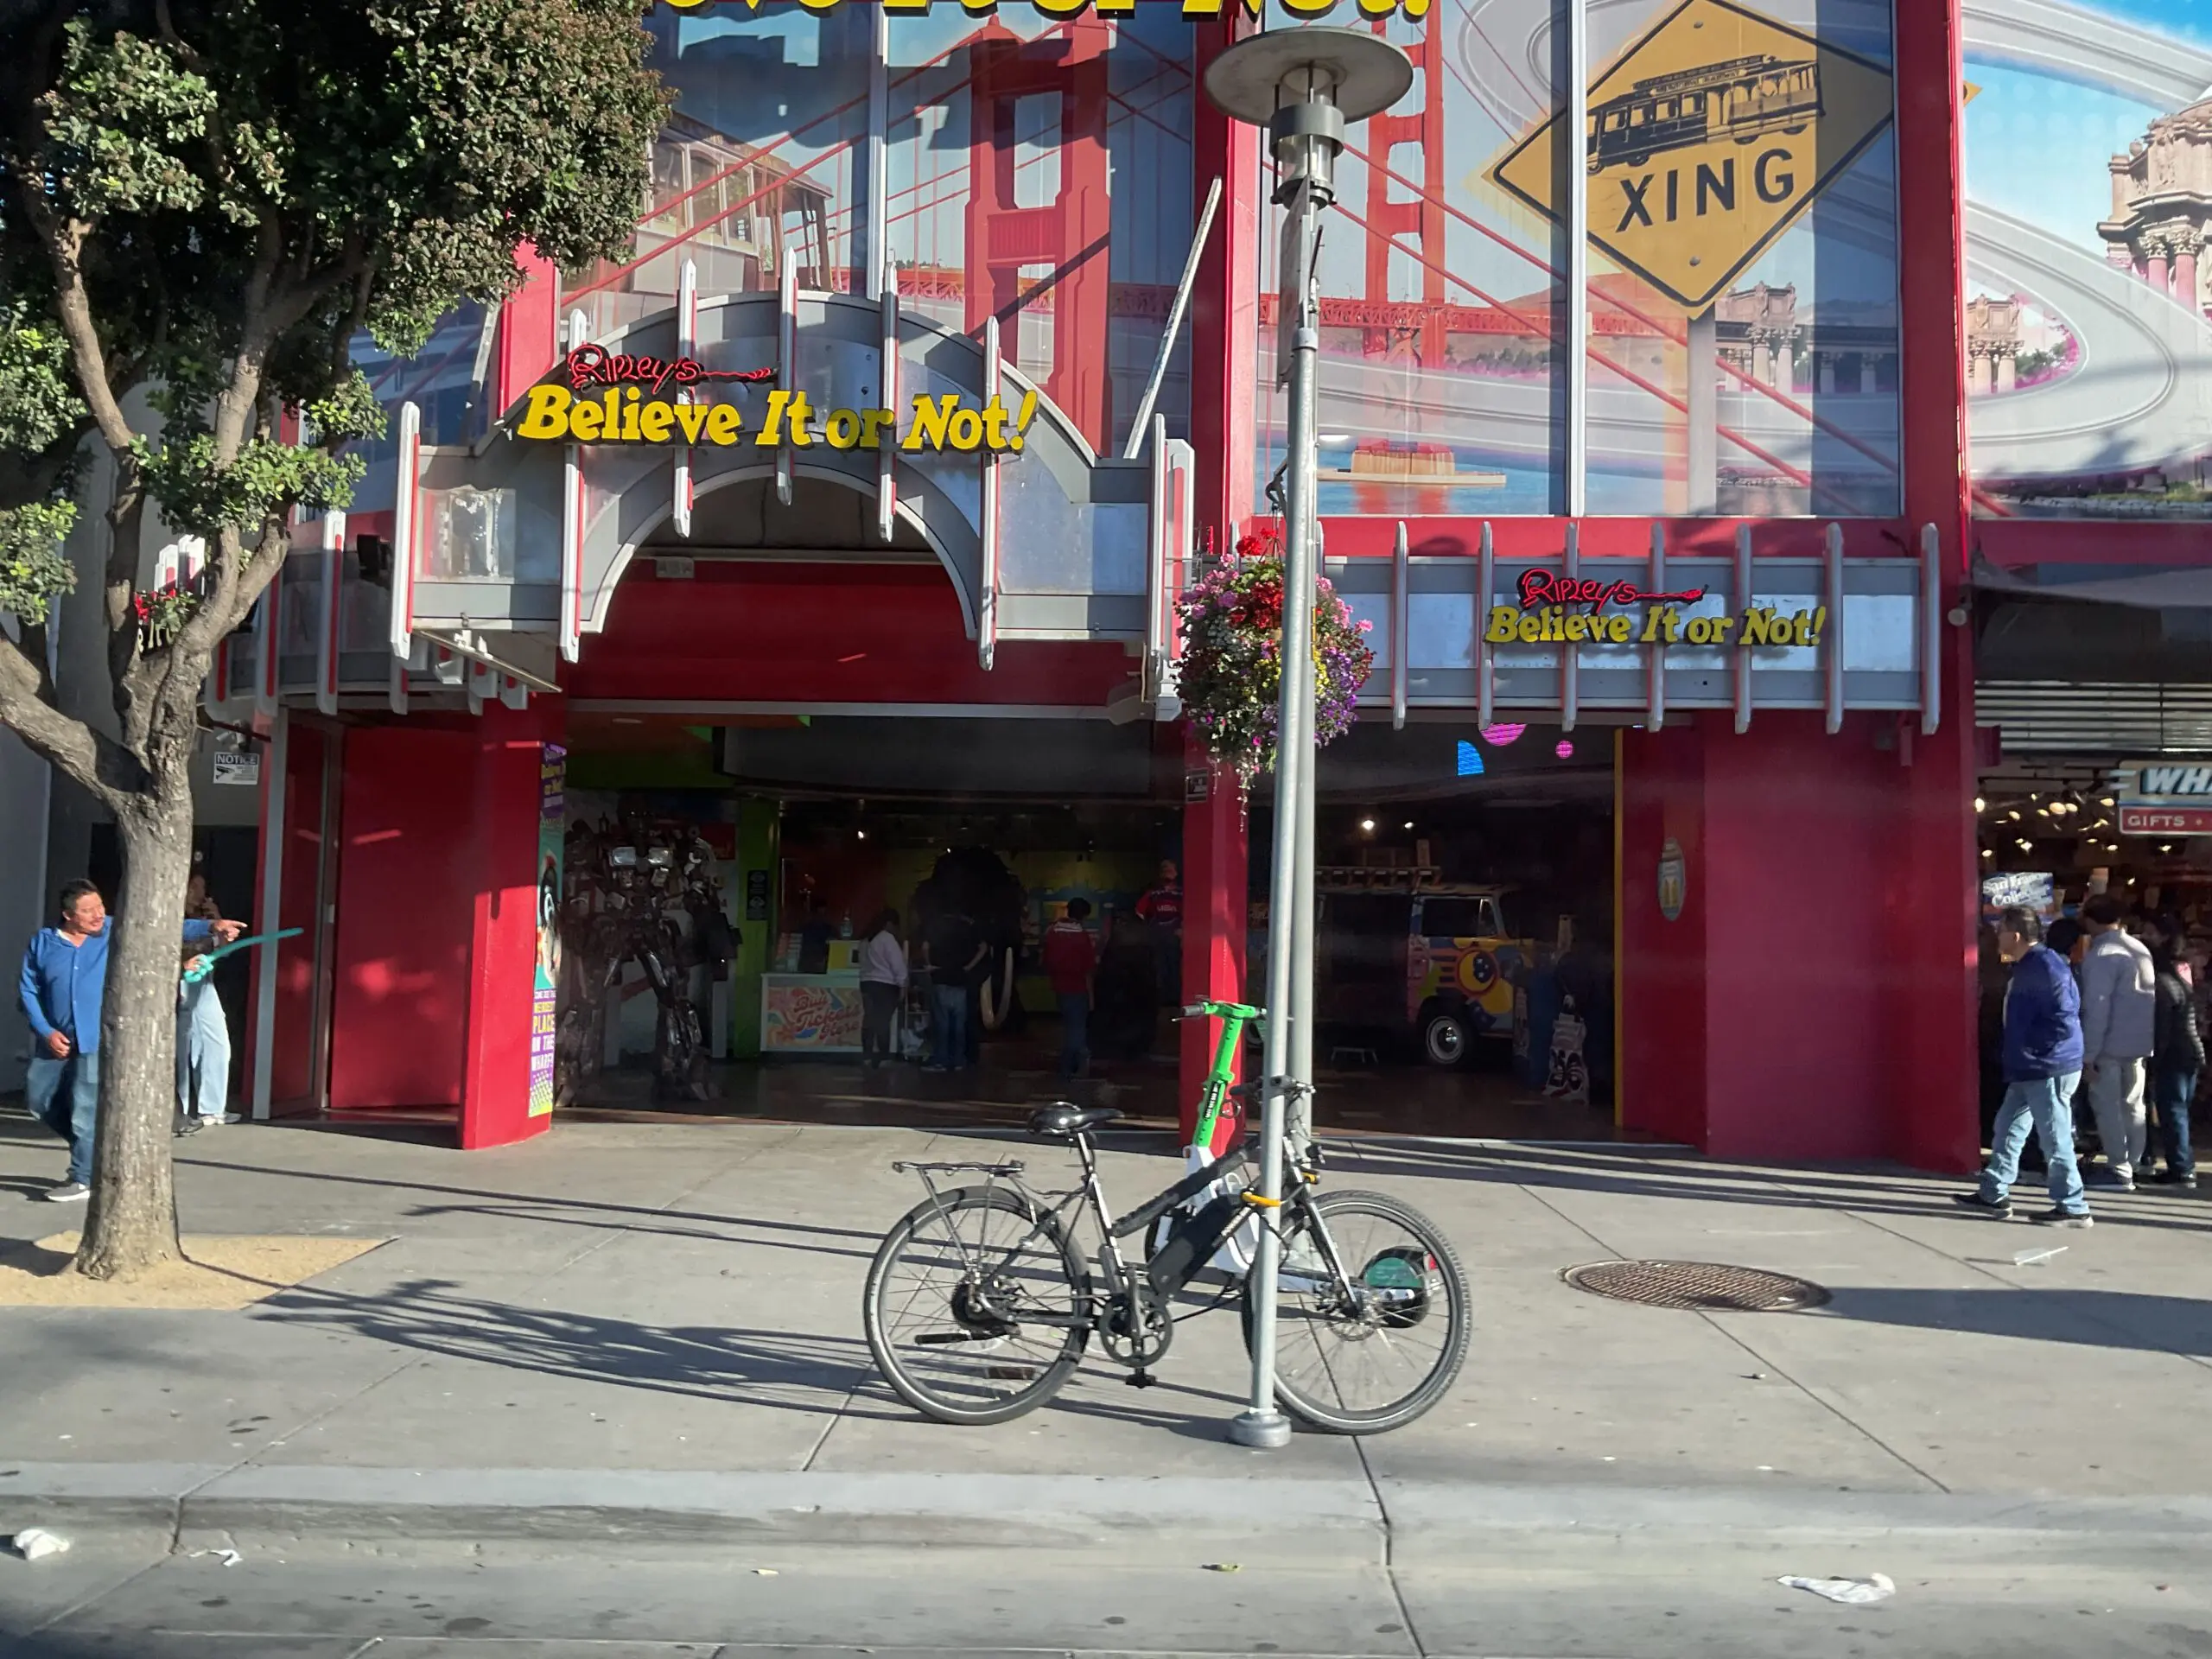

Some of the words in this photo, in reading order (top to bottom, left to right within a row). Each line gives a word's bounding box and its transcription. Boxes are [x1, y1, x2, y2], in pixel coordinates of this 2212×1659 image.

[1616, 149, 1795, 233] XING
[517, 385, 744, 446] Believe
[756, 390, 813, 448] It
[825, 407, 894, 449] or
[901, 390, 1039, 453] Not!
[1485, 606, 1631, 643] Believe
[1640, 606, 1680, 643] It
[1688, 616, 1734, 644] or
[1738, 607, 1827, 647] Not!
[217, 754, 257, 765] NOTICE
[2140, 767, 2212, 795] WH
[2127, 815, 2185, 827] GIFTS
